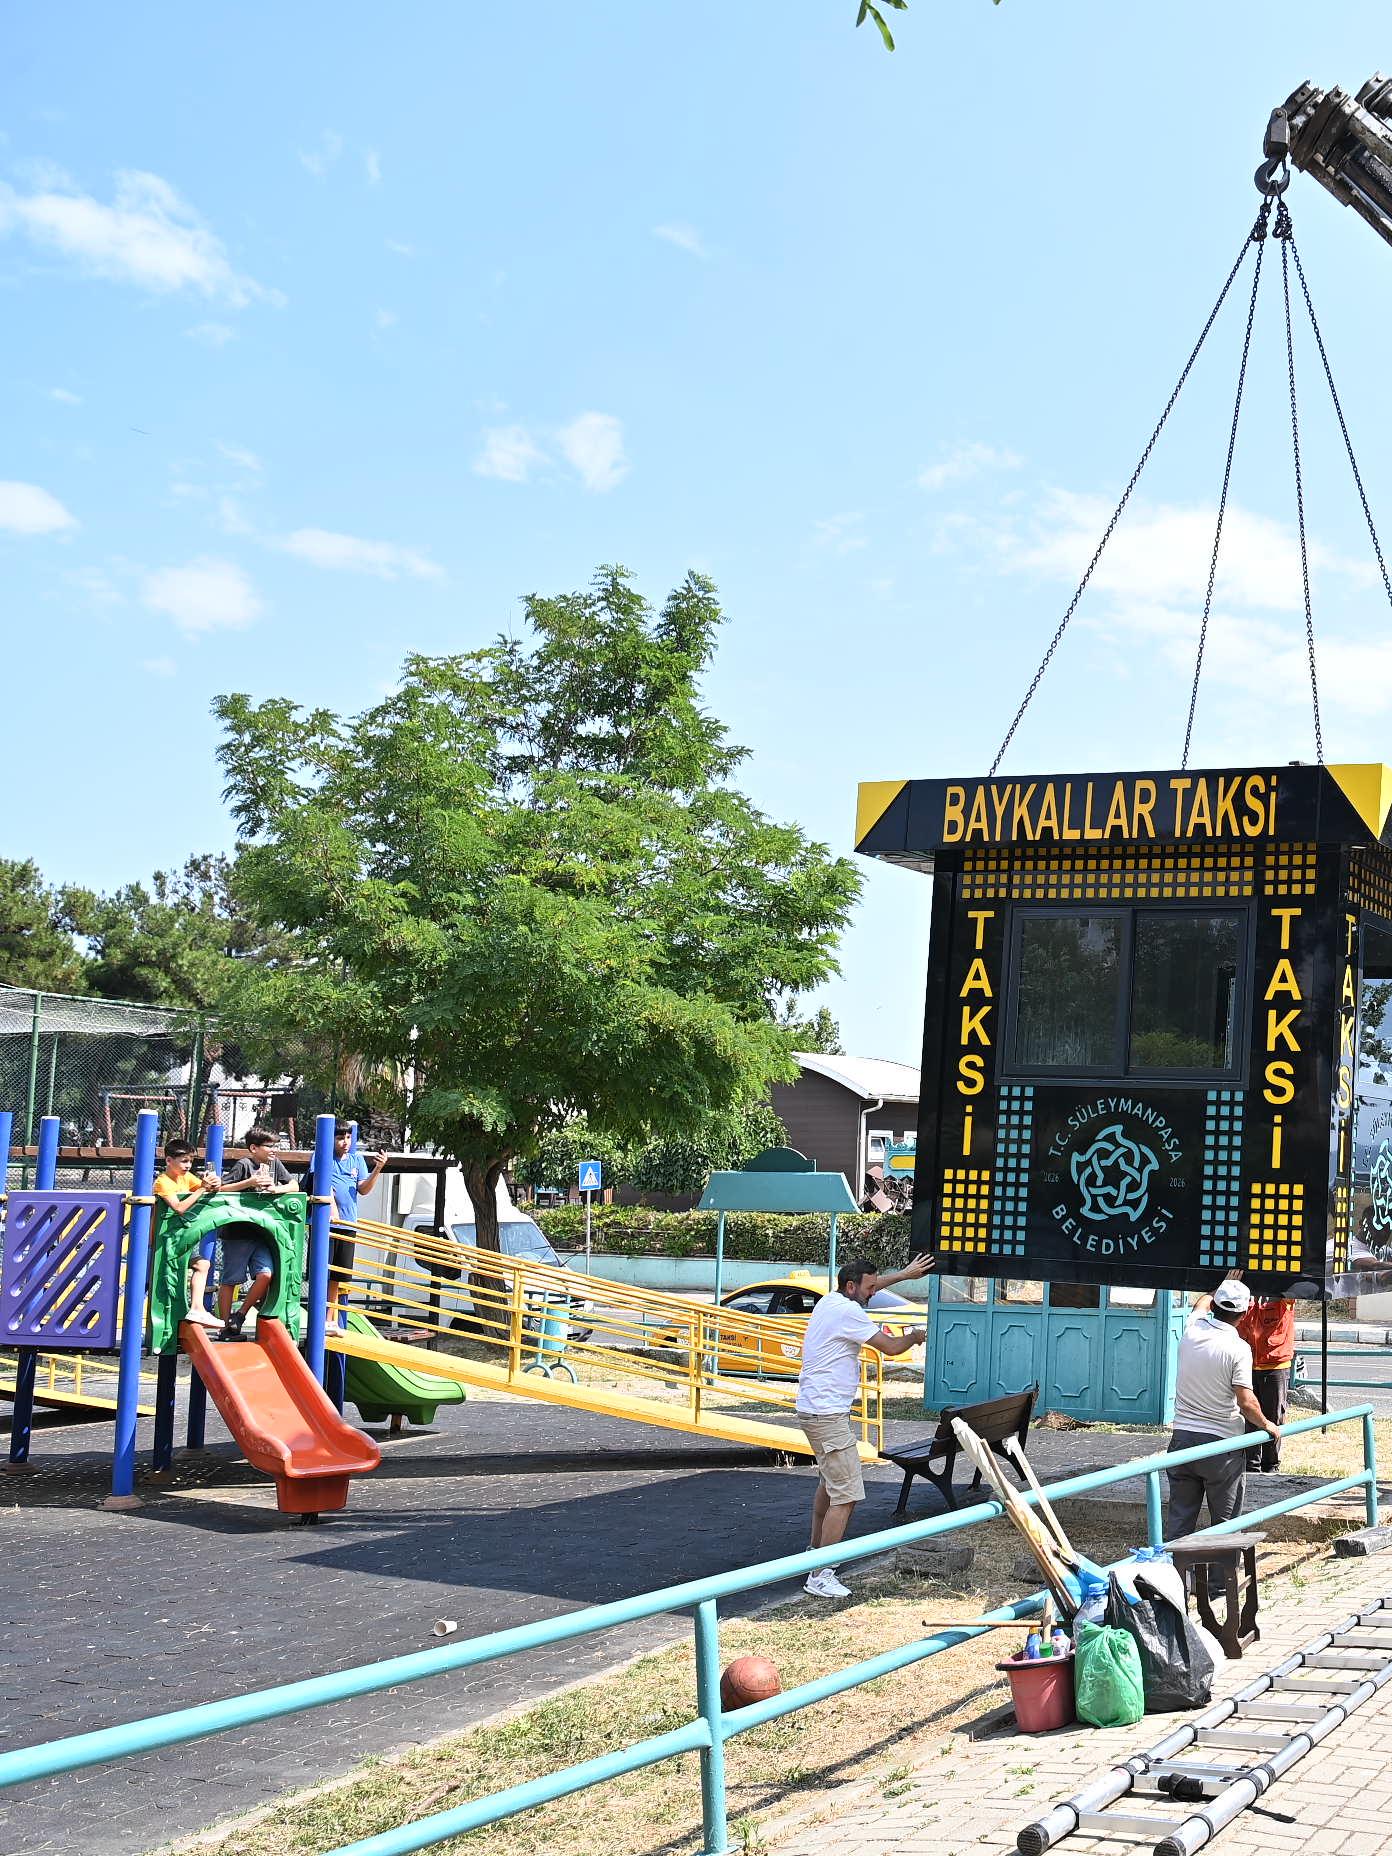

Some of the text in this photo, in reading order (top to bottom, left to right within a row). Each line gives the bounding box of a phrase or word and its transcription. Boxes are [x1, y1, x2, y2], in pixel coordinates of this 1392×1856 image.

[943, 778, 1156, 843] BAYKALLAR
[1067, 1097, 1183, 1163] SÜLEYMANPAŞA
[1052, 1203, 1175, 1255] BELEDİYESİ
